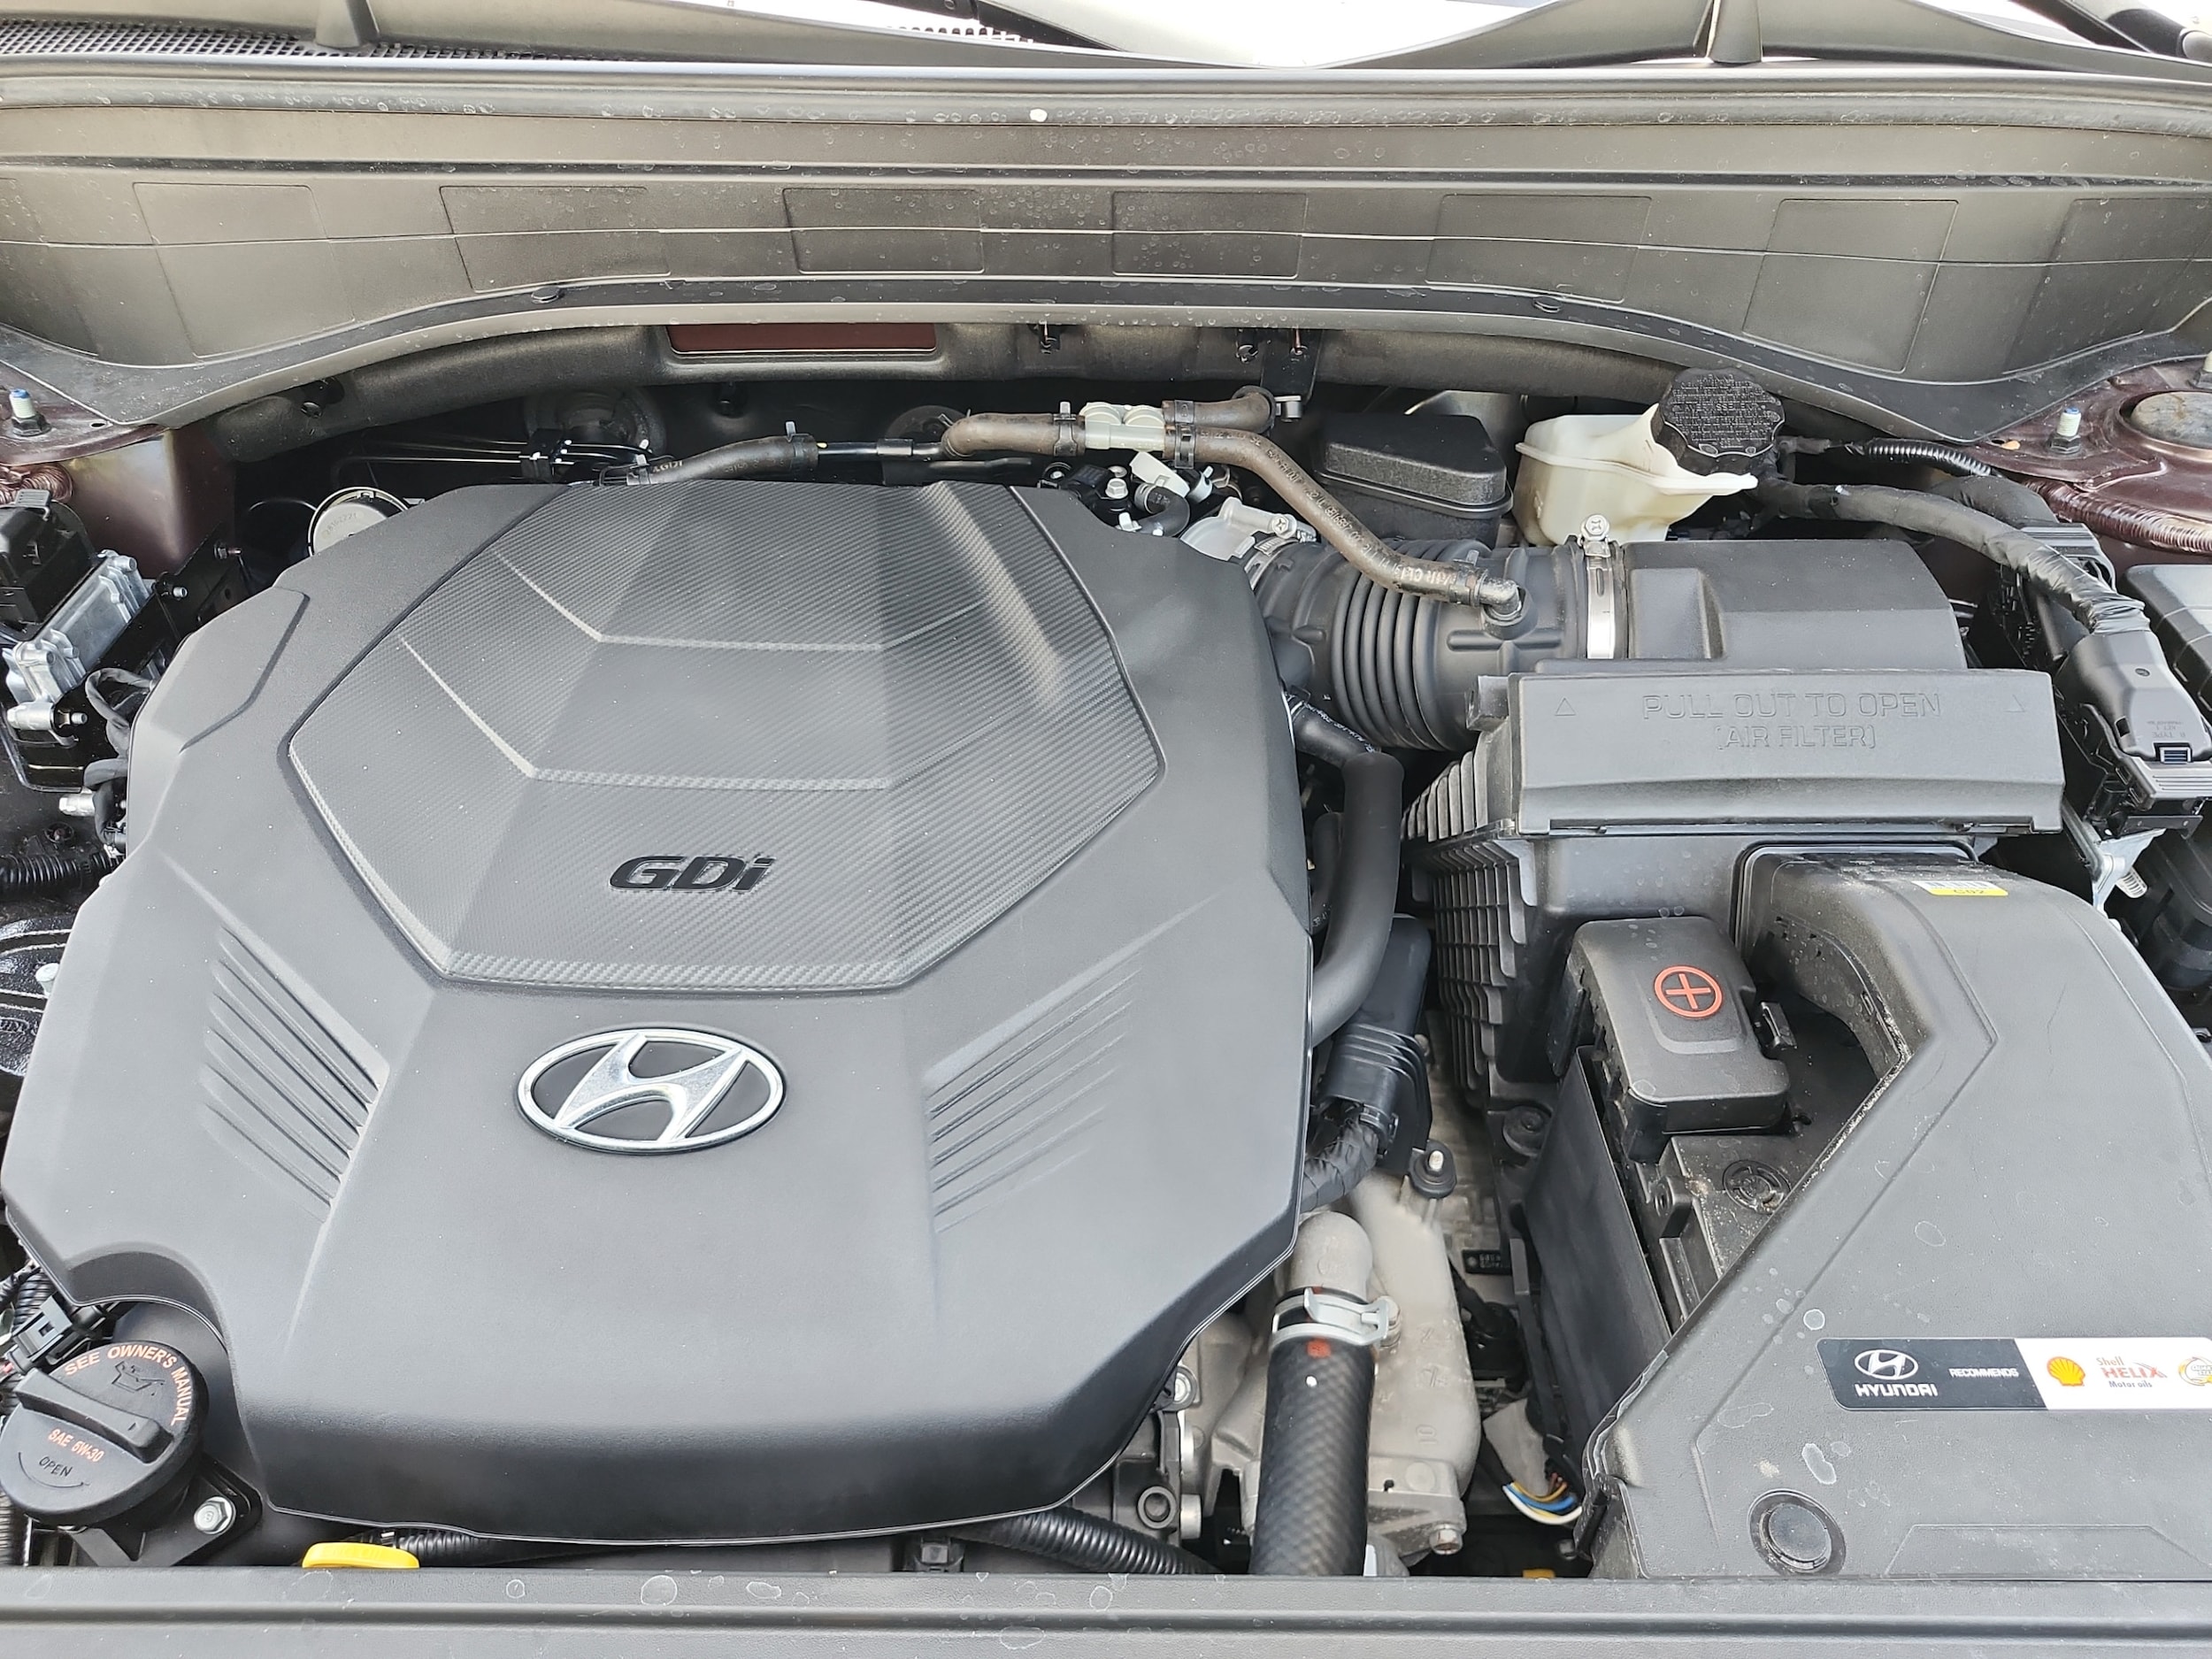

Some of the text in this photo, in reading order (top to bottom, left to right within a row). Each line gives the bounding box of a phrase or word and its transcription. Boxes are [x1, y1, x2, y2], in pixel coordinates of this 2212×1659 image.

[1643, 693, 1941, 719] PULL OUT TO OPEN
[1778, 724, 1877, 749] FILTER)
[609, 855, 776, 892] GDi
[2096, 1356, 2124, 1365] Shell
[1949, 1368, 2019, 1378] RECOMMENDS
[2101, 1367, 2166, 1378] HELIX
[65, 1344, 191, 1426] SEE OWNER'S MANUAL
[1855, 1384, 1938, 1396] HYUNDAI
[48, 1428, 74, 1448] SAE
[39, 1456, 73, 1477] OPEN
